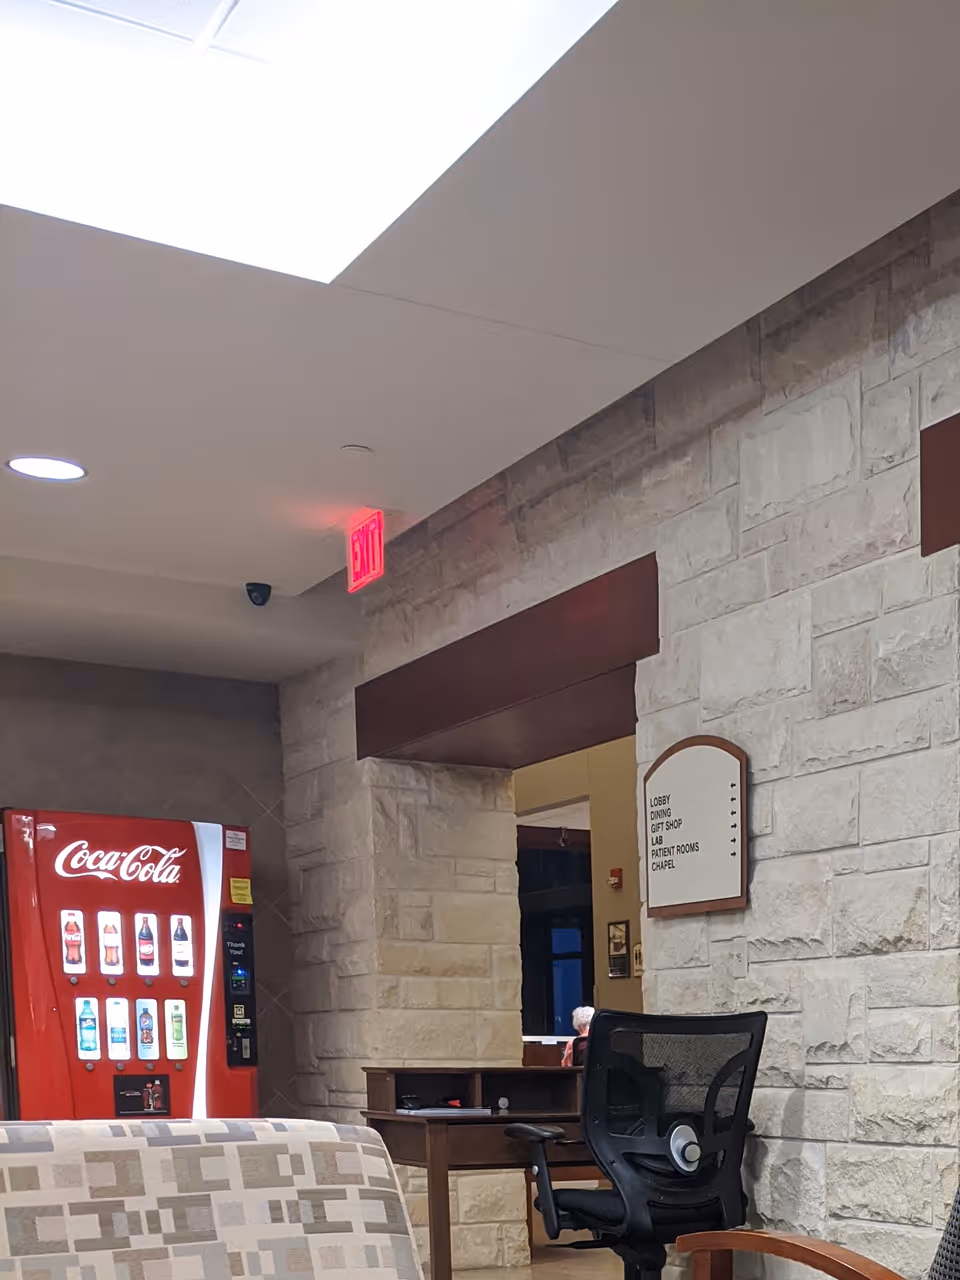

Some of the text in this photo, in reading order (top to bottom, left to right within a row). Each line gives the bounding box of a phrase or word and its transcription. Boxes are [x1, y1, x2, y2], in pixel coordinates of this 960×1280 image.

[352, 518, 377, 583] EXIT
[649, 794, 671, 808] LOBBY
[650, 807, 672, 821] DINING
[650, 818, 683, 833] GIFT SHOP
[651, 835, 663, 846] LAB
[651, 841, 700, 859] PATIENT ROOMS
[54, 840, 187, 884] Coca-Cola
[651, 858, 675, 872] CHAPEL
[226, 941, 246, 949] Thank
